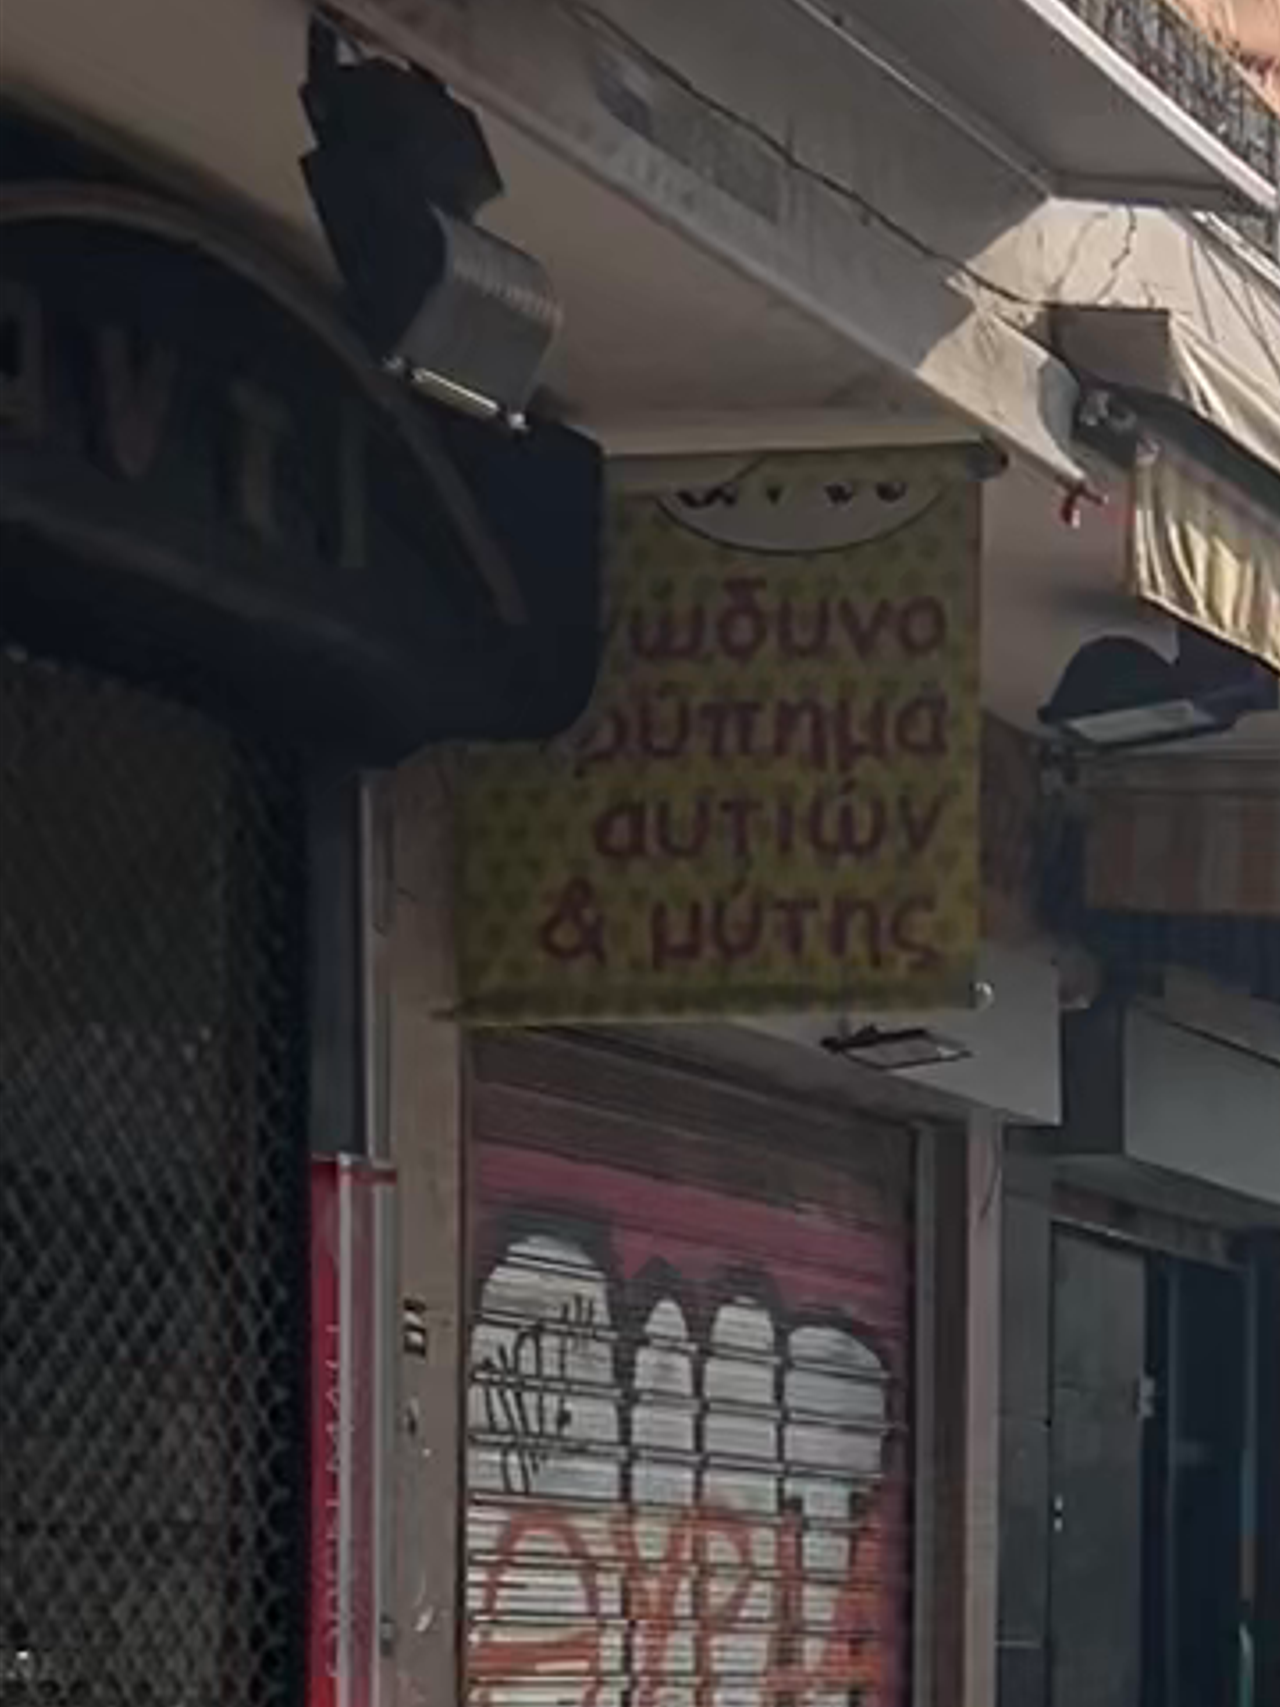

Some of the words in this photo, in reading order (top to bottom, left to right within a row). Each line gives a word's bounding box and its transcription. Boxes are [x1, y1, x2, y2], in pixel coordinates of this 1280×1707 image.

[594, 778, 948, 859] αυτιών
[537, 876, 606, 968] &
[650, 876, 943, 971] μύτης
